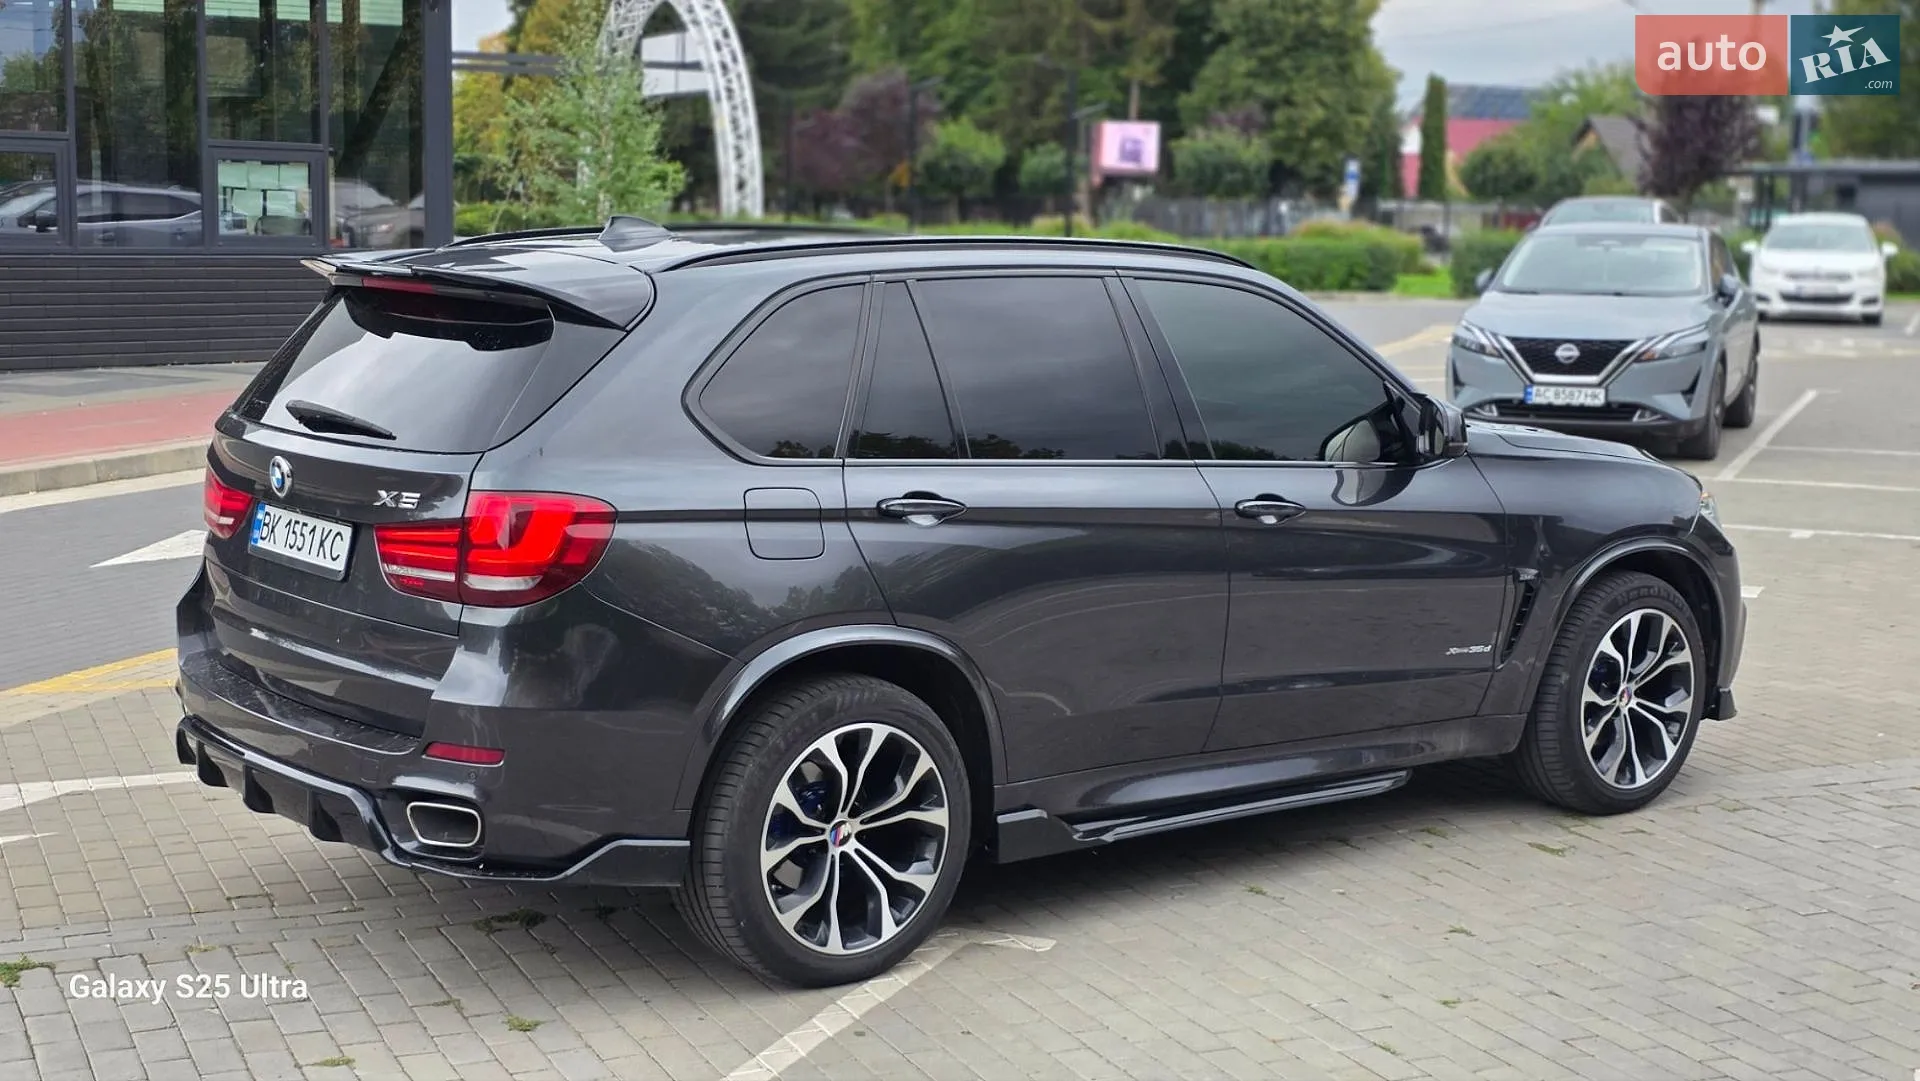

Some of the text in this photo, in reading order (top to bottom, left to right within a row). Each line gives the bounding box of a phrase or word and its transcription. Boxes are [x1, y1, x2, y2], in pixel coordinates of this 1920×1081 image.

[372, 489, 421, 509] X5
[260, 511, 344, 562] BK 1551 KC
